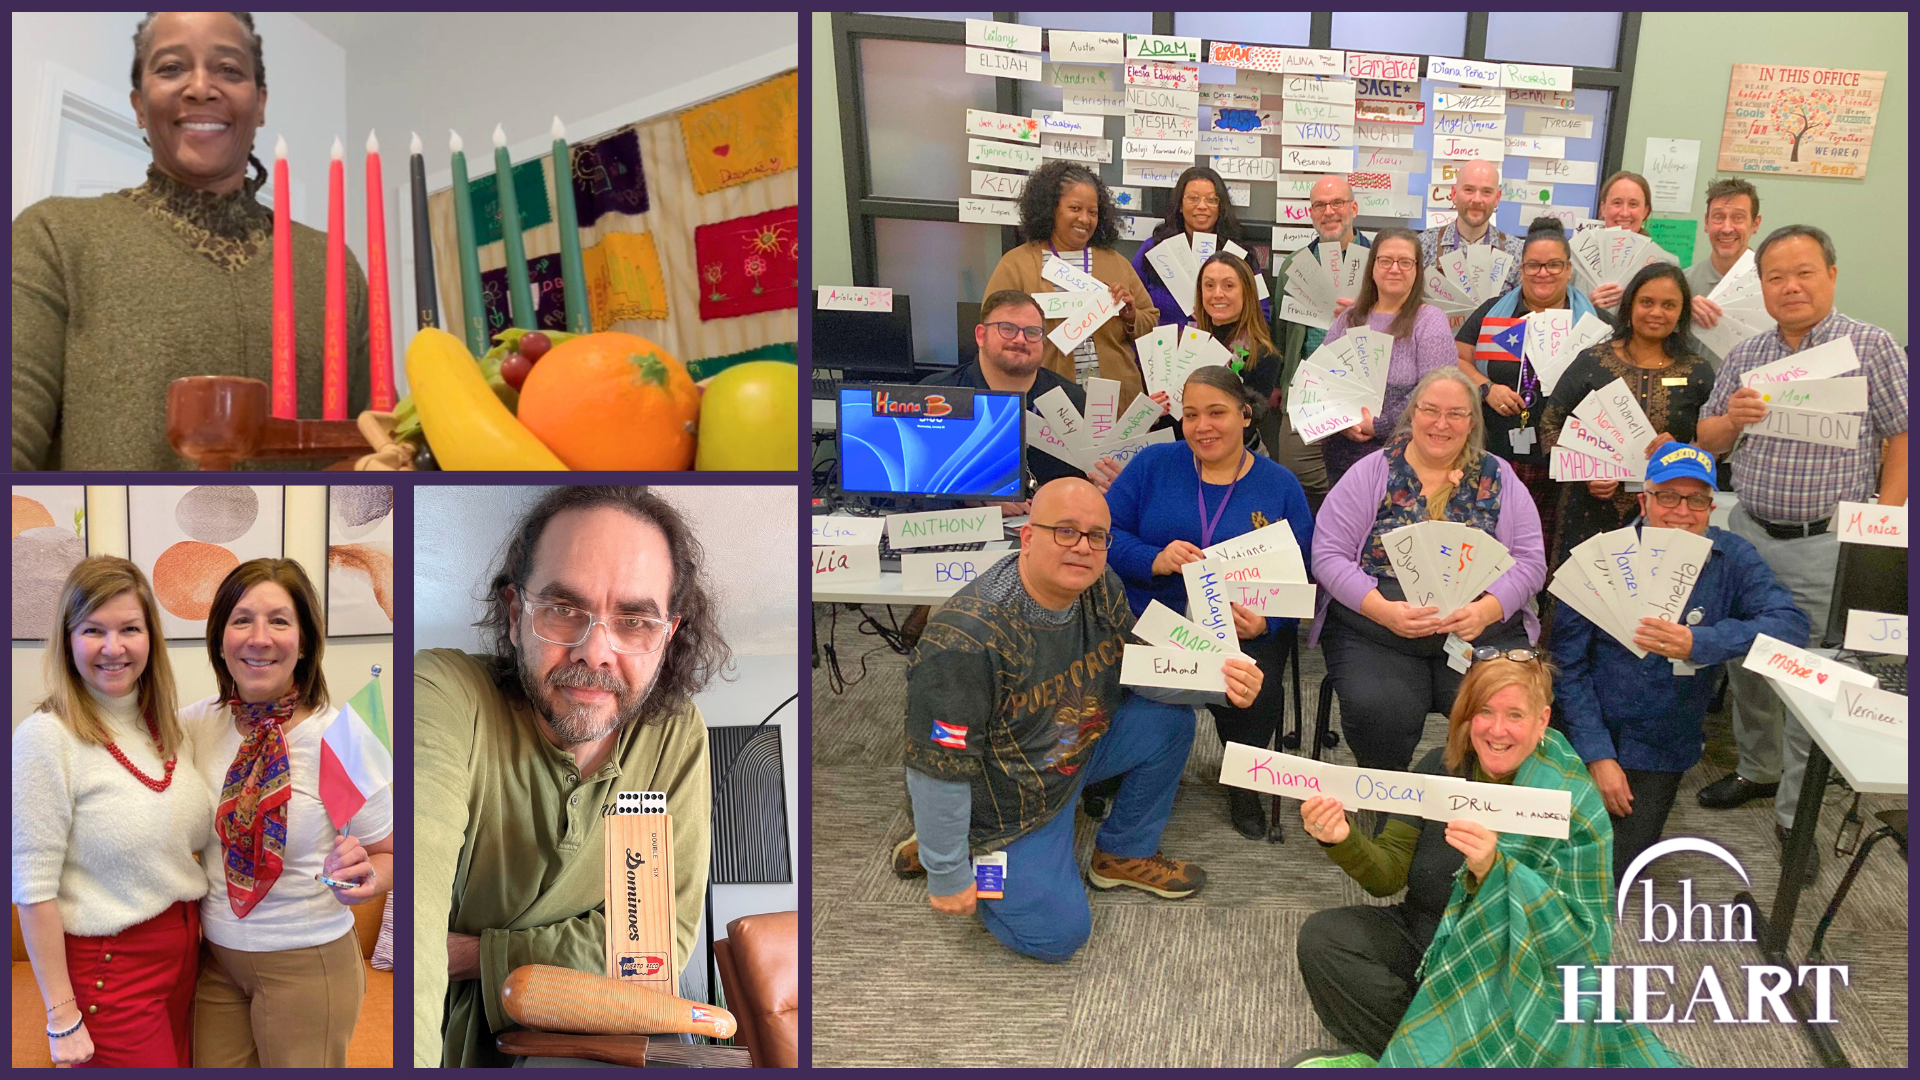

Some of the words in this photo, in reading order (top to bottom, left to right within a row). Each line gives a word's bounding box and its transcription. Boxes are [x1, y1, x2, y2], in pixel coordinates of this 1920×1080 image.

[1069, 41, 1096, 52] Austin
[1214, 45, 1253, 63] BRIAN
[980, 54, 1028, 72] ELIJAH
[1431, 62, 1462, 77] Diana
[1758, 67, 1775, 82] IN
[1778, 68, 1810, 84] THIS
[1812, 70, 1861, 87] OFFICE
[1358, 79, 1402, 97] SAGE
[1737, 89, 1773, 101] helpful
[1072, 95, 1125, 107] Christian
[1126, 88, 1175, 108] NELSON
[1443, 92, 1501, 110] DANIEL
[1127, 113, 1177, 130] TYESHA
[1735, 107, 1766, 118] Goals
[1296, 123, 1341, 141] VENUS
[1540, 116, 1582, 130] TYRONE
[1744, 119, 1768, 139] fun
[1358, 125, 1400, 143] NOAH
[1828, 131, 1865, 146] Together
[1443, 138, 1480, 157] James
[1814, 146, 1829, 156] WE
[1830, 147, 1850, 158] ARE
[1288, 150, 1333, 168] Reserved
[1652, 154, 1688, 174] Welcome
[1810, 161, 1855, 176] Team
[980, 173, 1021, 193] KEV
[1363, 195, 1390, 207] Juan
[1063, 311, 1098, 341] Gen
[876, 391, 921, 413] Hanna
[923, 394, 953, 417] B
[1056, 407, 1077, 436] Nicky
[1303, 414, 1353, 438] Neesha
[1613, 394, 1647, 440] Shanell
[1593, 409, 1625, 445] Norma
[901, 514, 987, 538] ANTHONY
[1846, 511, 1901, 537] Monica
[815, 550, 850, 575] Lia
[935, 561, 978, 583] BOB
[1235, 586, 1268, 611] Judy
[1153, 657, 1199, 676] Edmond
[1247, 756, 1322, 793] Kiana
[1354, 773, 1426, 803] Oscar
[1530, 811, 1570, 823] ANDREW
[651, 832, 659, 860] DOUBLE
[625, 847, 646, 942] Dominoes
[623, 961, 644, 970] PUERTO
[645, 961, 660, 970] RICO
